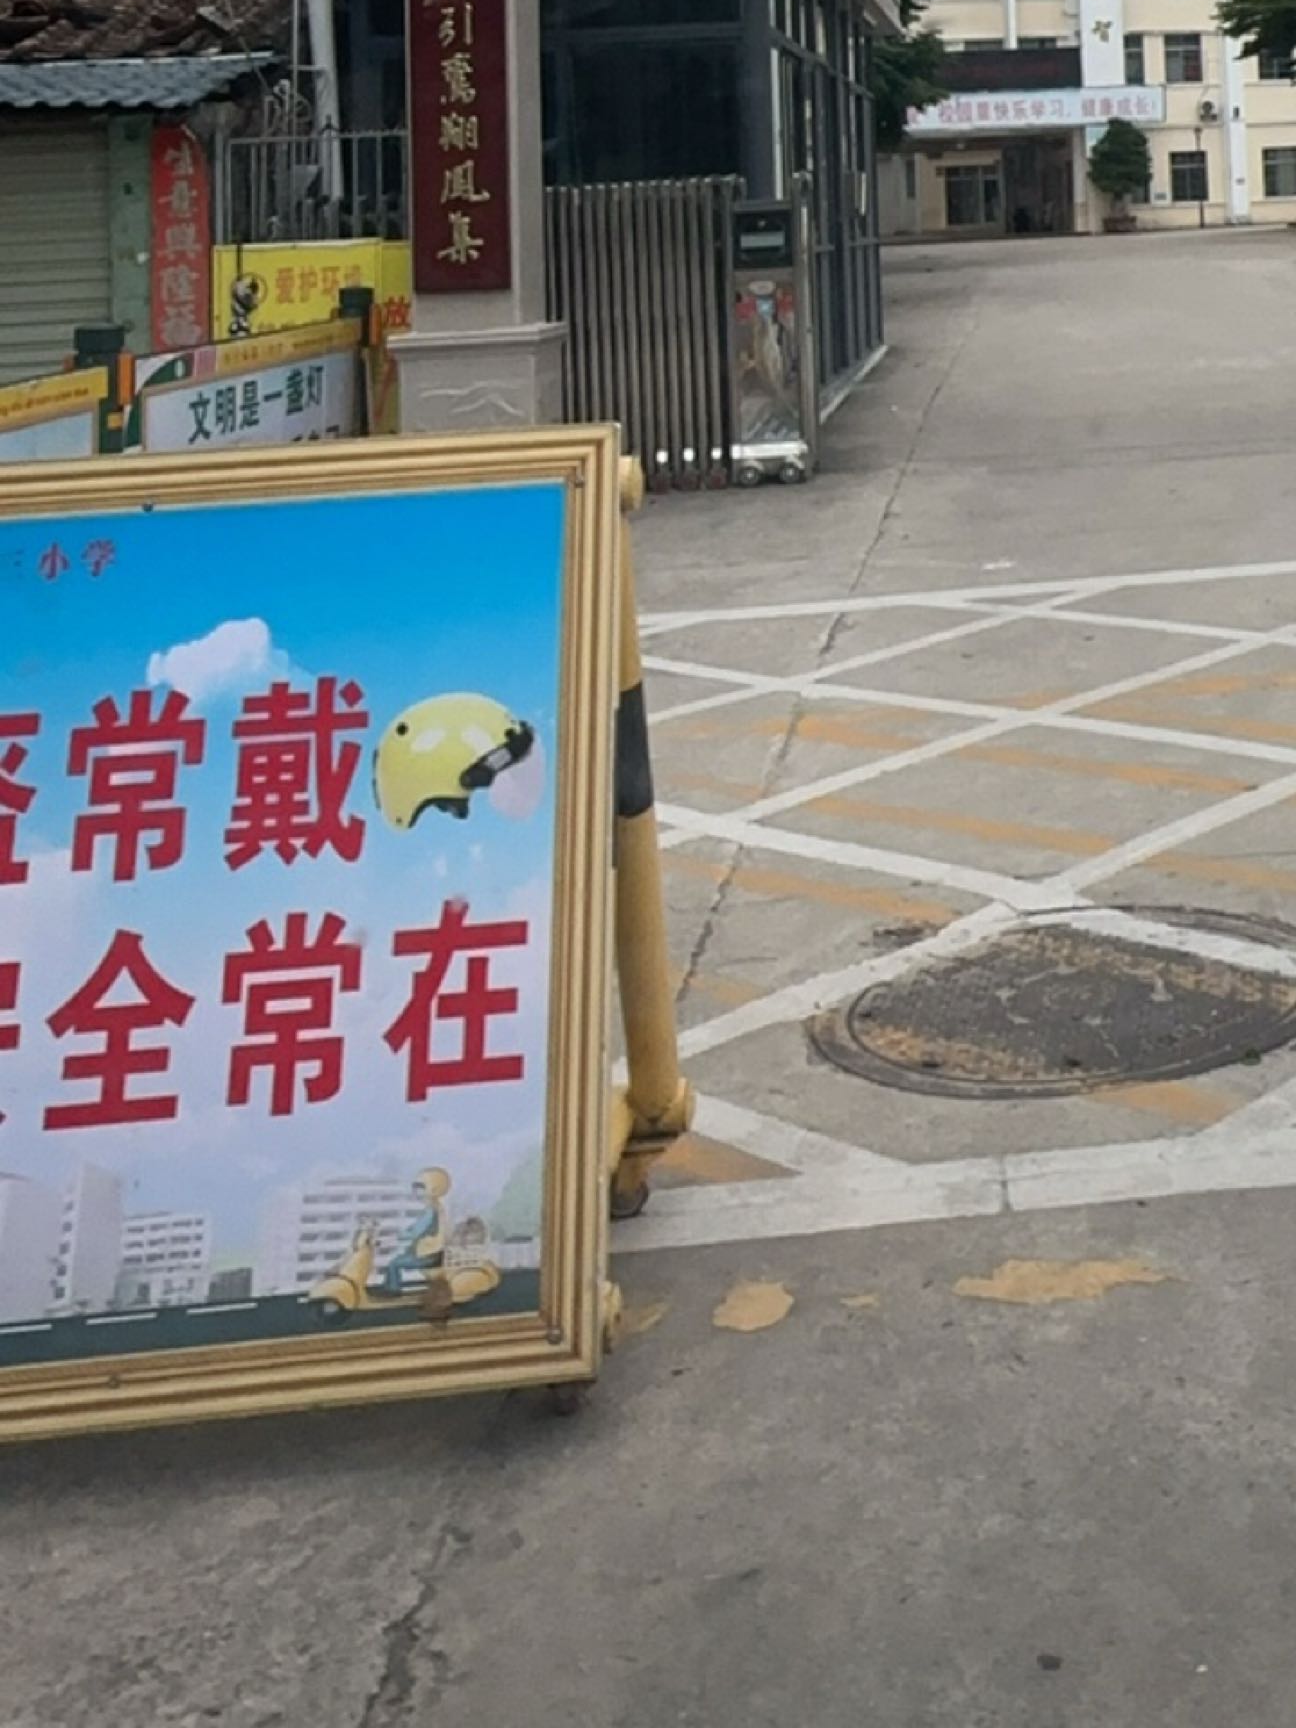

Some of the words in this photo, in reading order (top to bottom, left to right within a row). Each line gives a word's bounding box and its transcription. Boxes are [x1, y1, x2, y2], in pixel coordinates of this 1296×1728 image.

[188, 365, 324, 446] 文明是一盏灯
[0, 899, 529, 1132] 全常在
